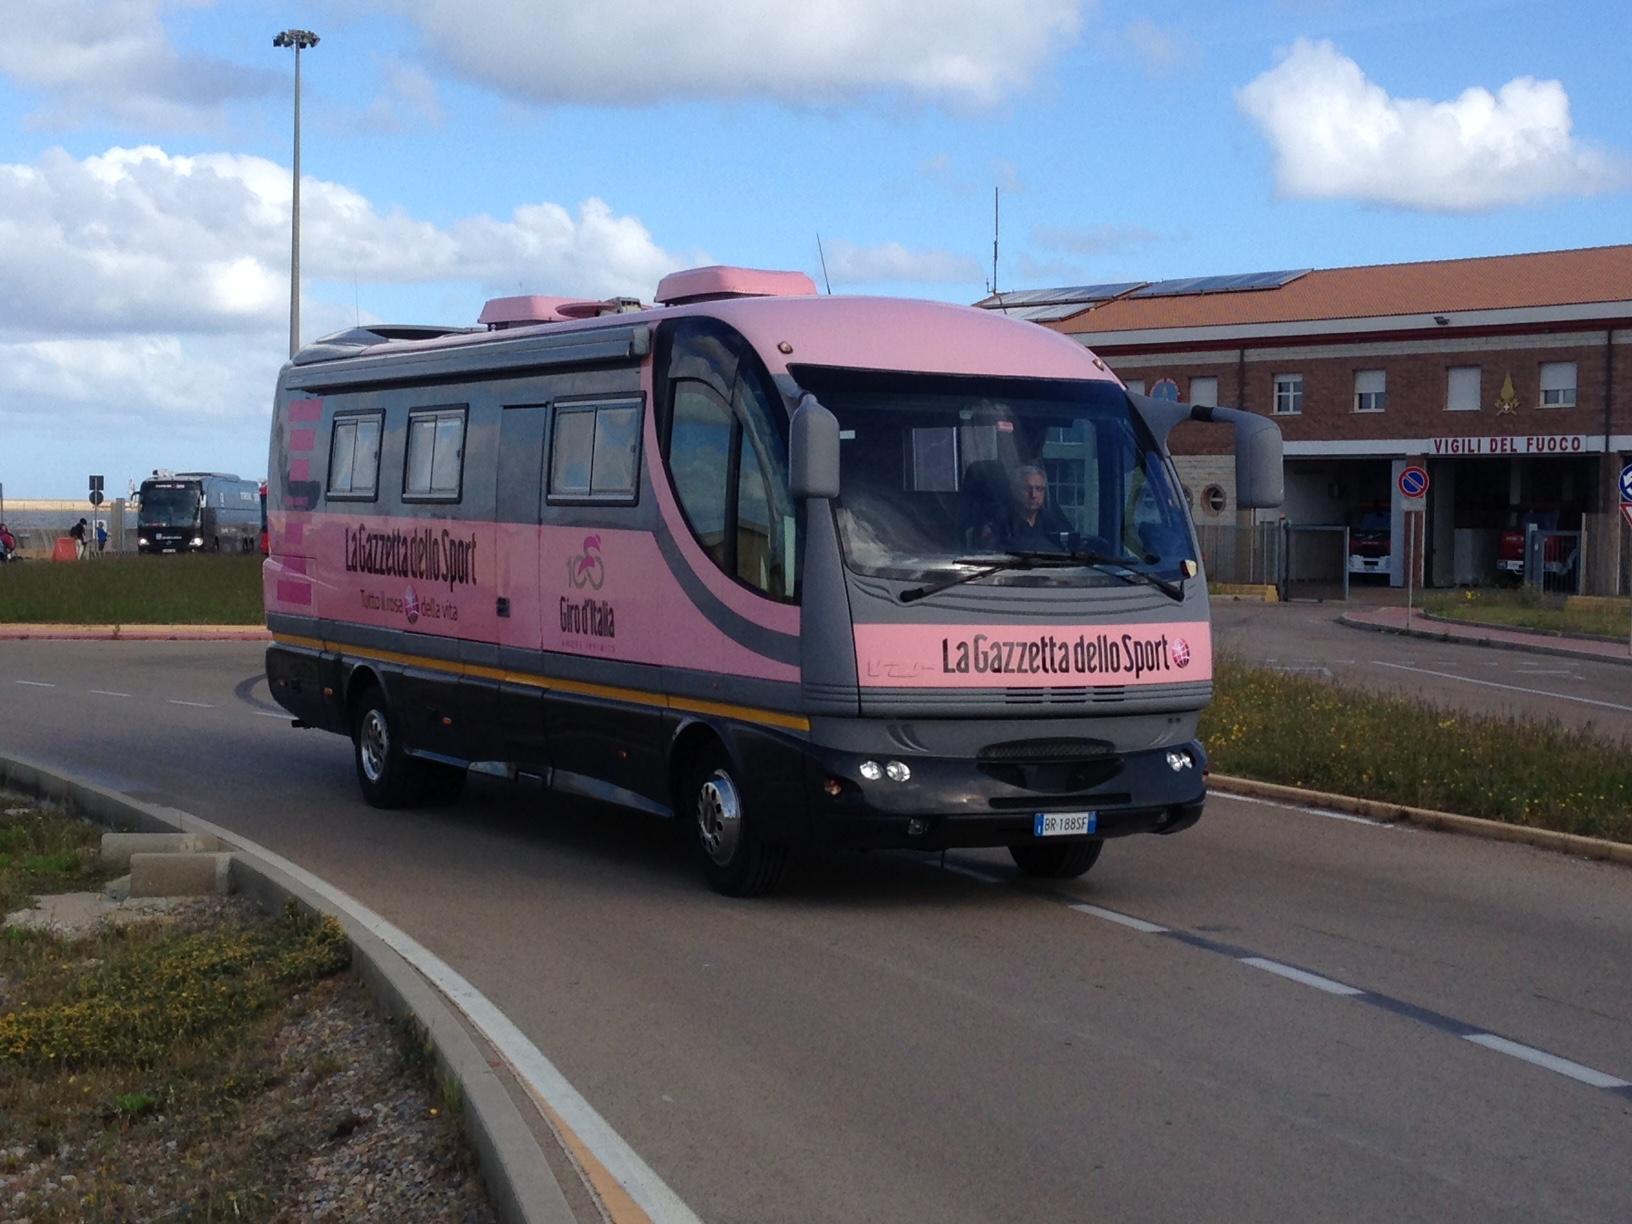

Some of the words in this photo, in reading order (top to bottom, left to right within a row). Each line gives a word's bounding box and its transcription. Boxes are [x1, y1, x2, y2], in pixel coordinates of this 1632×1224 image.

[1434, 438, 1482, 454] VIGILI
[1489, 437, 1518, 453] DEL
[1526, 436, 1581, 452] FUOCO
[345, 527, 358, 573] La
[358, 522, 409, 578] Gazzetta
[410, 527, 441, 582] dello
[441, 528, 478, 593] Sport
[421, 595, 441, 619] della
[442, 599, 459, 621] vita
[560, 594, 581, 635] Giro
[581, 597, 616, 639] d'Italia
[942, 637, 970, 674] La
[973, 633, 1070, 674] Gazzetta
[1073, 634, 1121, 674] dello
[1121, 633, 1171, 679] Sport
